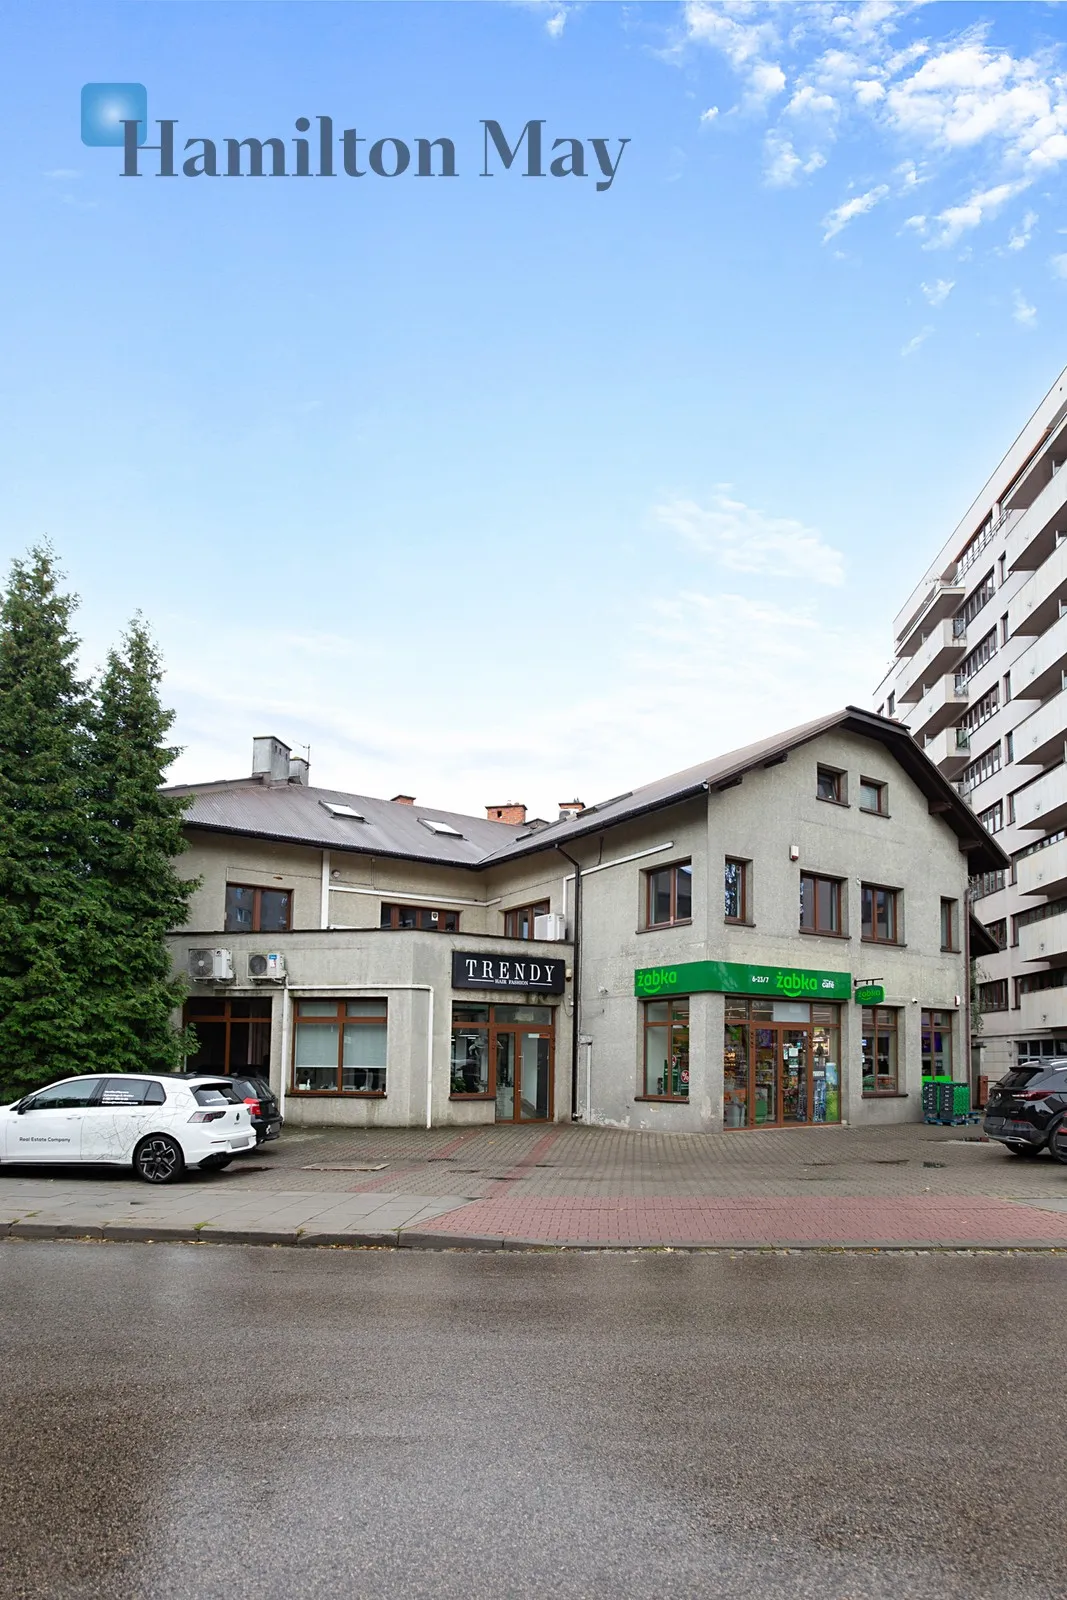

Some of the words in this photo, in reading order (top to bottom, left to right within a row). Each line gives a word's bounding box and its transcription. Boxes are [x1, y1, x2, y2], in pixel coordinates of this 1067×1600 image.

[465, 959, 555, 982] TRENDY
[637, 969, 677, 987] żabka
[776, 971, 818, 990] żabka
[48, 1136, 71, 1144] Company
